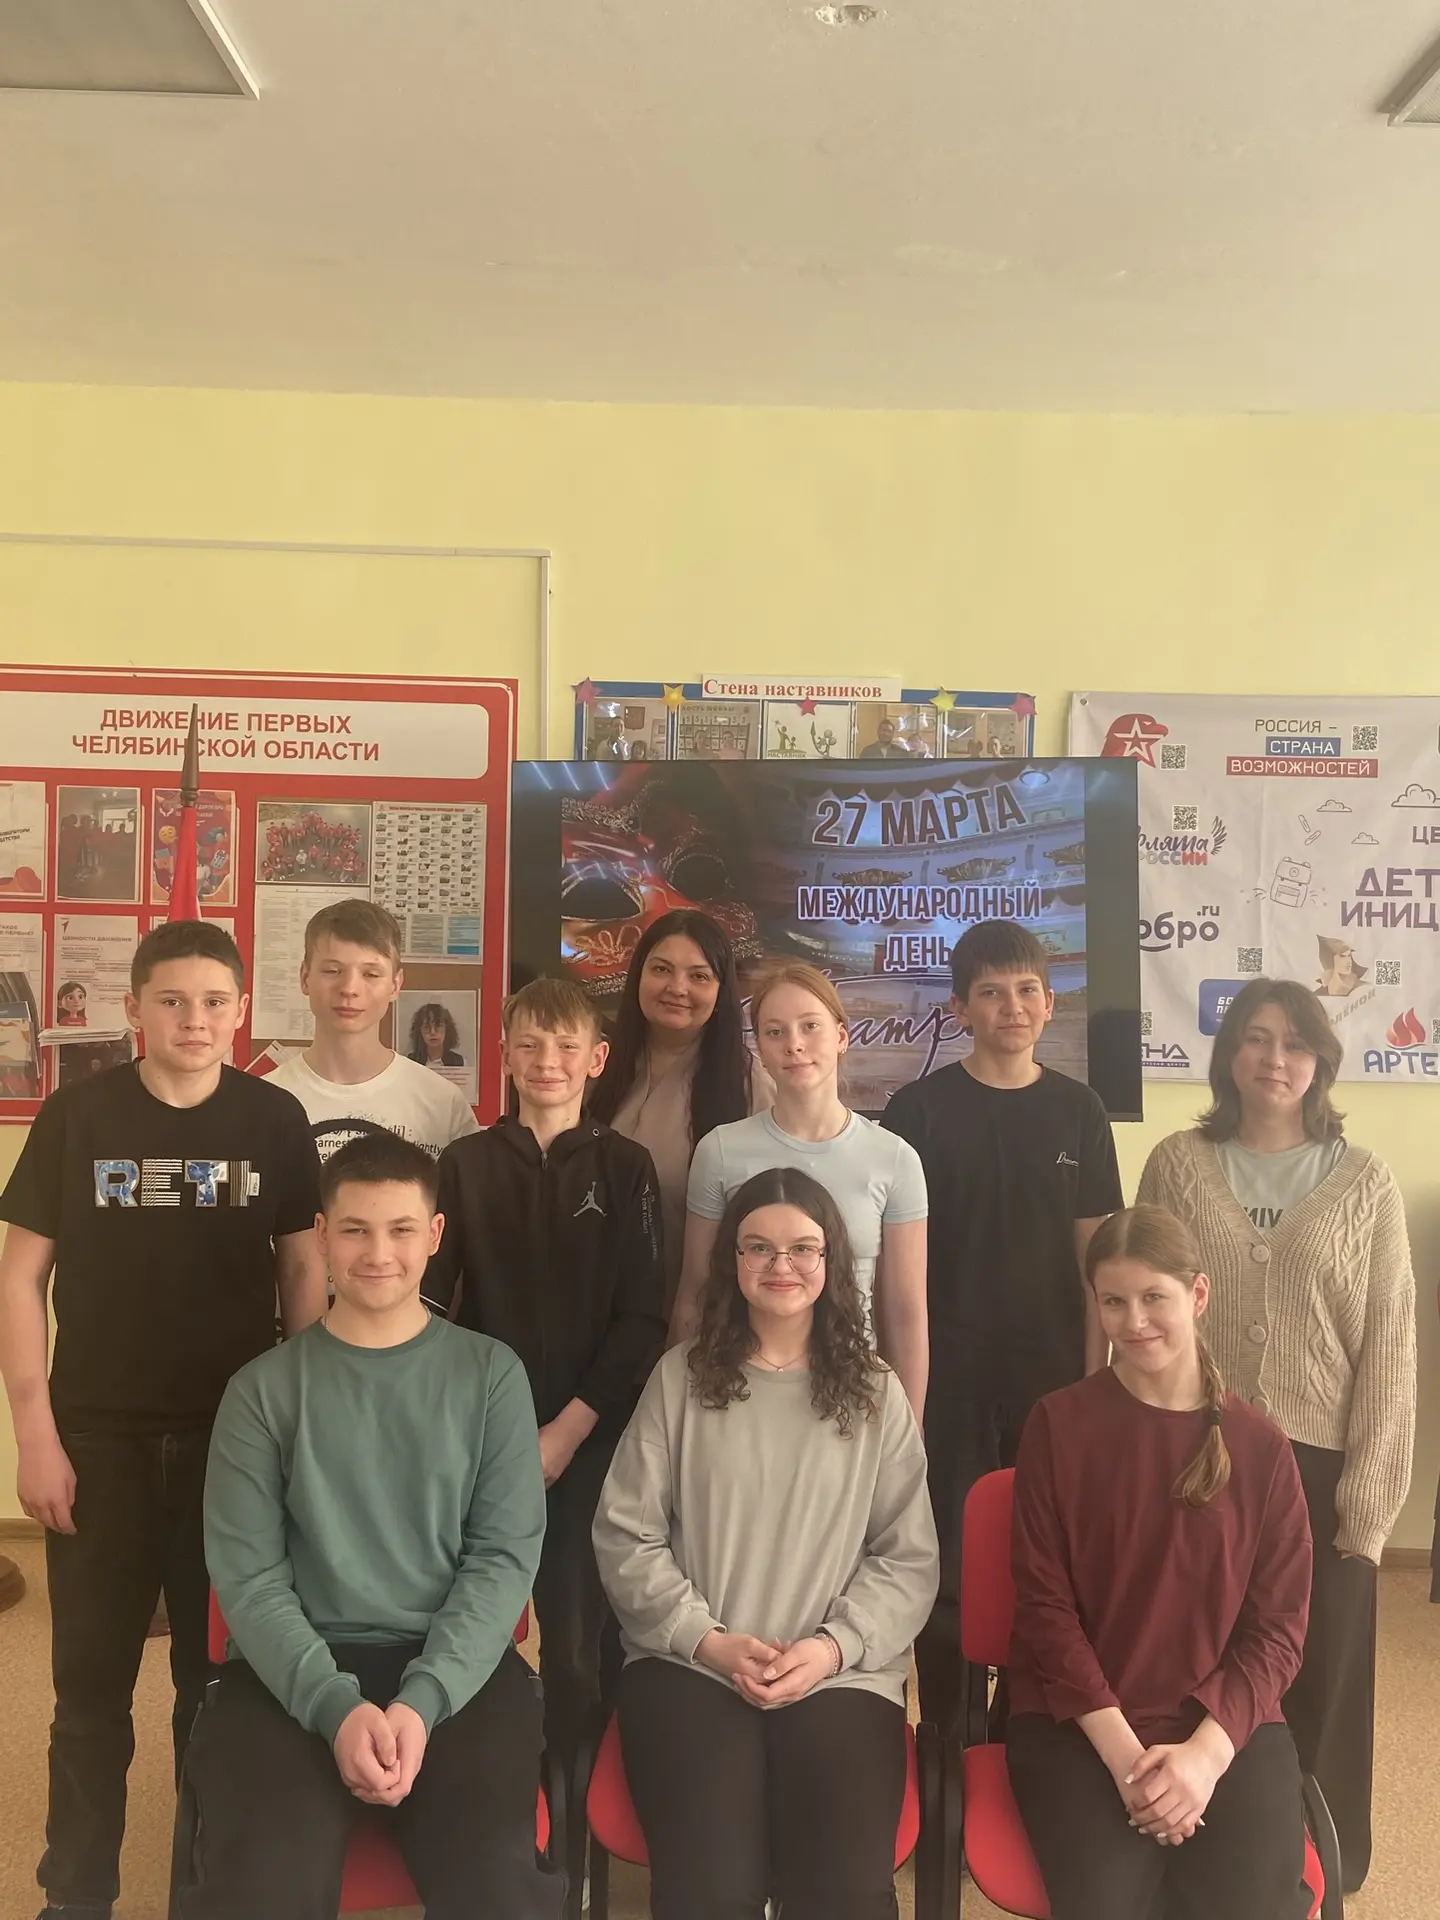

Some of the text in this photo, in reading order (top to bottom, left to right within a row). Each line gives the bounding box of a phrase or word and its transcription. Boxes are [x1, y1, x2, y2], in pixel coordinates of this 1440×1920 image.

[704, 679, 882, 698] Стена наставников
[247, 713, 352, 734] ПЕРВЫХ
[1255, 719, 1322, 734] РОССИЯ
[264, 740, 379, 761] ОБЛАСТИ
[1270, 740, 1335, 755] СТРАНА
[1231, 759, 1370, 776] ВОЗМОЖНОСТЕЙ
[812, 783, 1027, 847] 27 МАРТА
[1138, 833, 1209, 853] рлята
[1412, 826, 1440, 845] ЦЕ
[1356, 867, 1440, 898] ДЕТ
[798, 880, 1043, 923] МЕЖДУНАРОДНЫЙ
[1197, 905, 1220, 916] .ru
[1341, 901, 1440, 932] ИНИЦ
[1139, 911, 1219, 948] обро
[1364, 1050, 1439, 1075] АРТЕ
